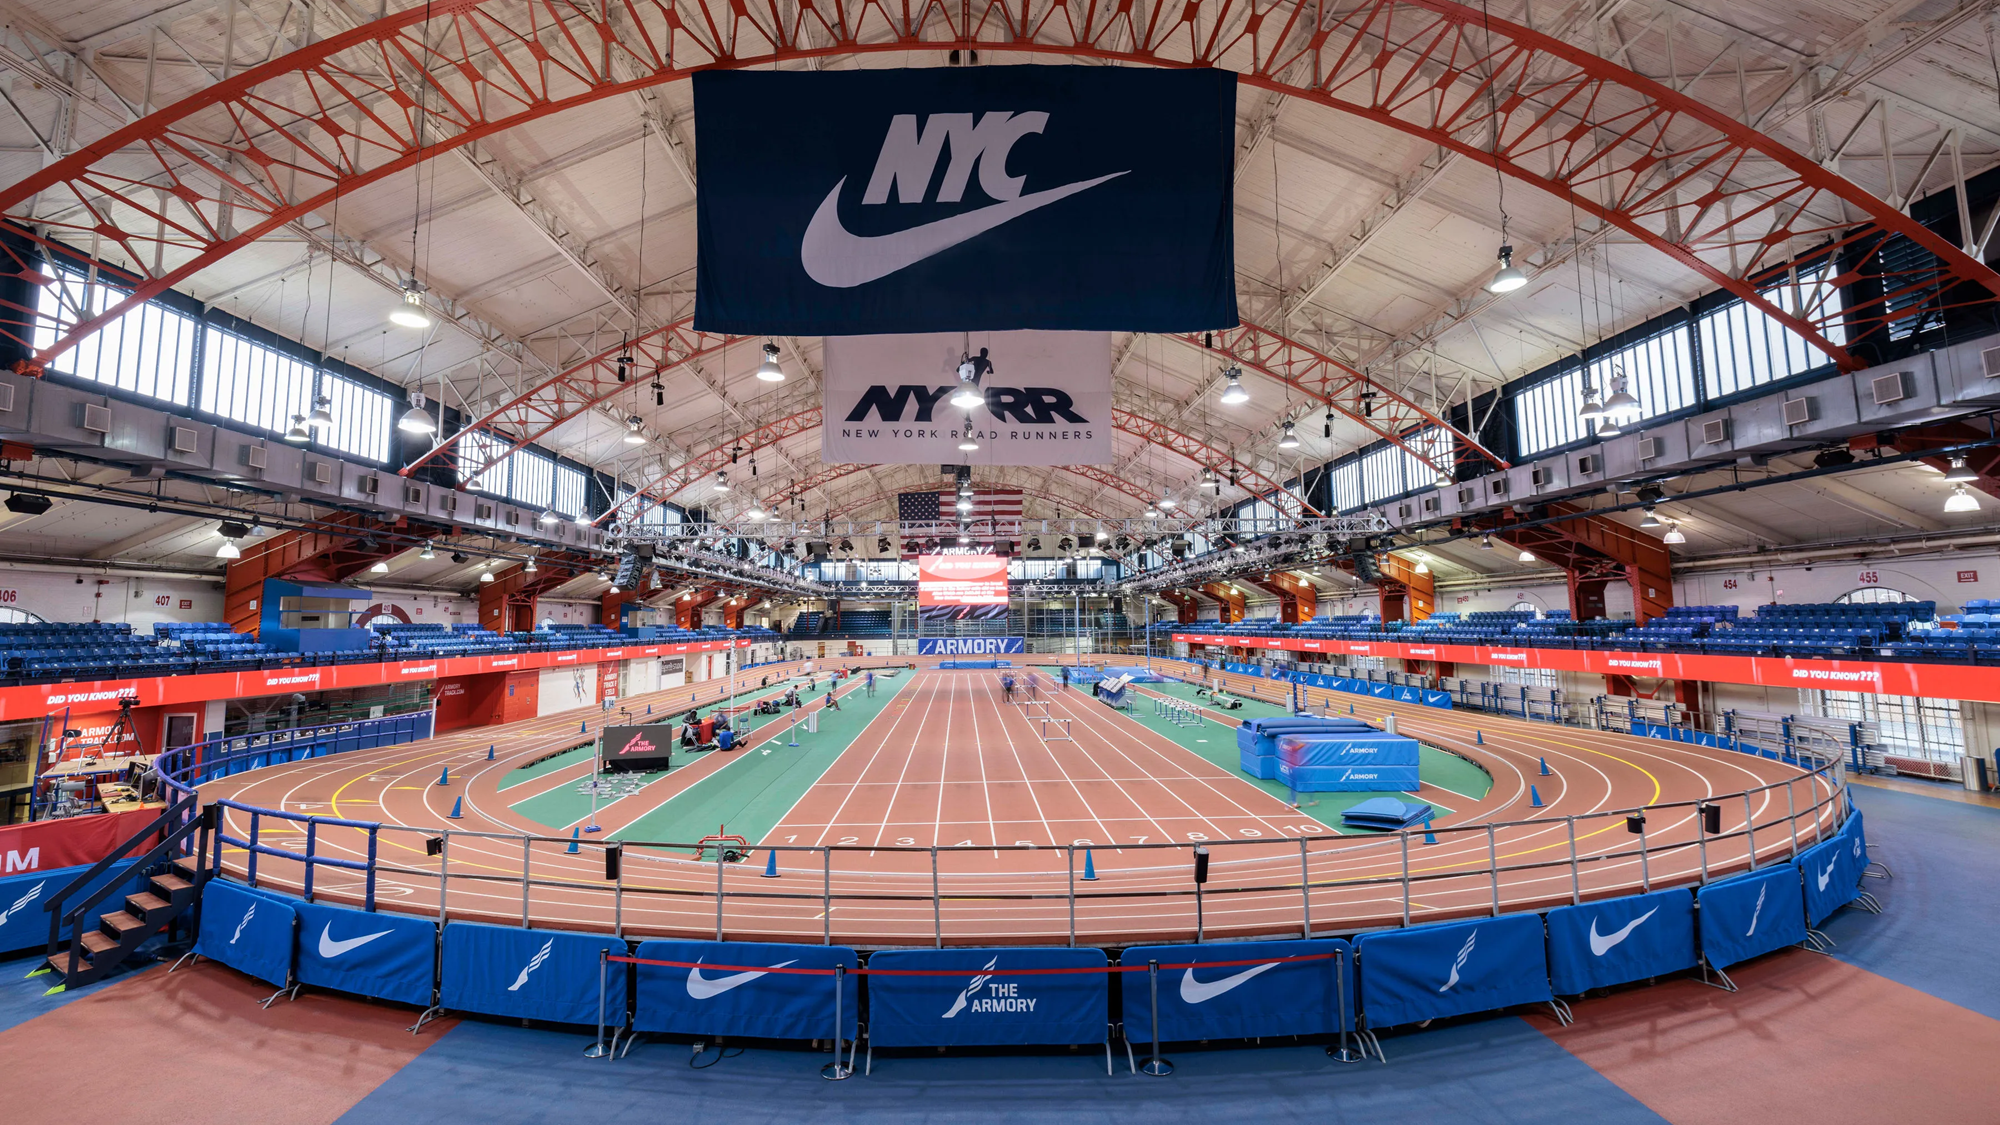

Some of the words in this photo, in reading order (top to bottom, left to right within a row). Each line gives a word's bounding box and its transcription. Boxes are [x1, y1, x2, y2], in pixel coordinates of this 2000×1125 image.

[862, 111, 1050, 204] NYC
[844, 385, 1090, 424] NYRR
[842, 429, 879, 438] NEW
[892, 429, 938, 438] YORK
[1010, 430, 1093, 441] RUNNERS
[1723, 579, 1738, 589] 454
[1859, 572, 1879, 584] 455
[155, 595, 170, 606] 407
[934, 638, 1008, 654] ARMORY
[1792, 669, 1809, 677] DID
[1809, 670, 1829, 679] YOU
[1830, 671, 1880, 682] KNOW???
[46, 695, 66, 704] DID
[67, 693, 88, 703] YOU
[88, 688, 135, 701] KNOW???
[1239, 828, 1262, 837] 9
[1283, 824, 1323, 834] 10
[784, 834, 798, 844] 1
[837, 836, 860, 845] 2
[895, 837, 916, 846] 3
[1186, 832, 1209, 841] 8
[988, 983, 1018, 997] THE
[971, 998, 1037, 1013] ARMORY
